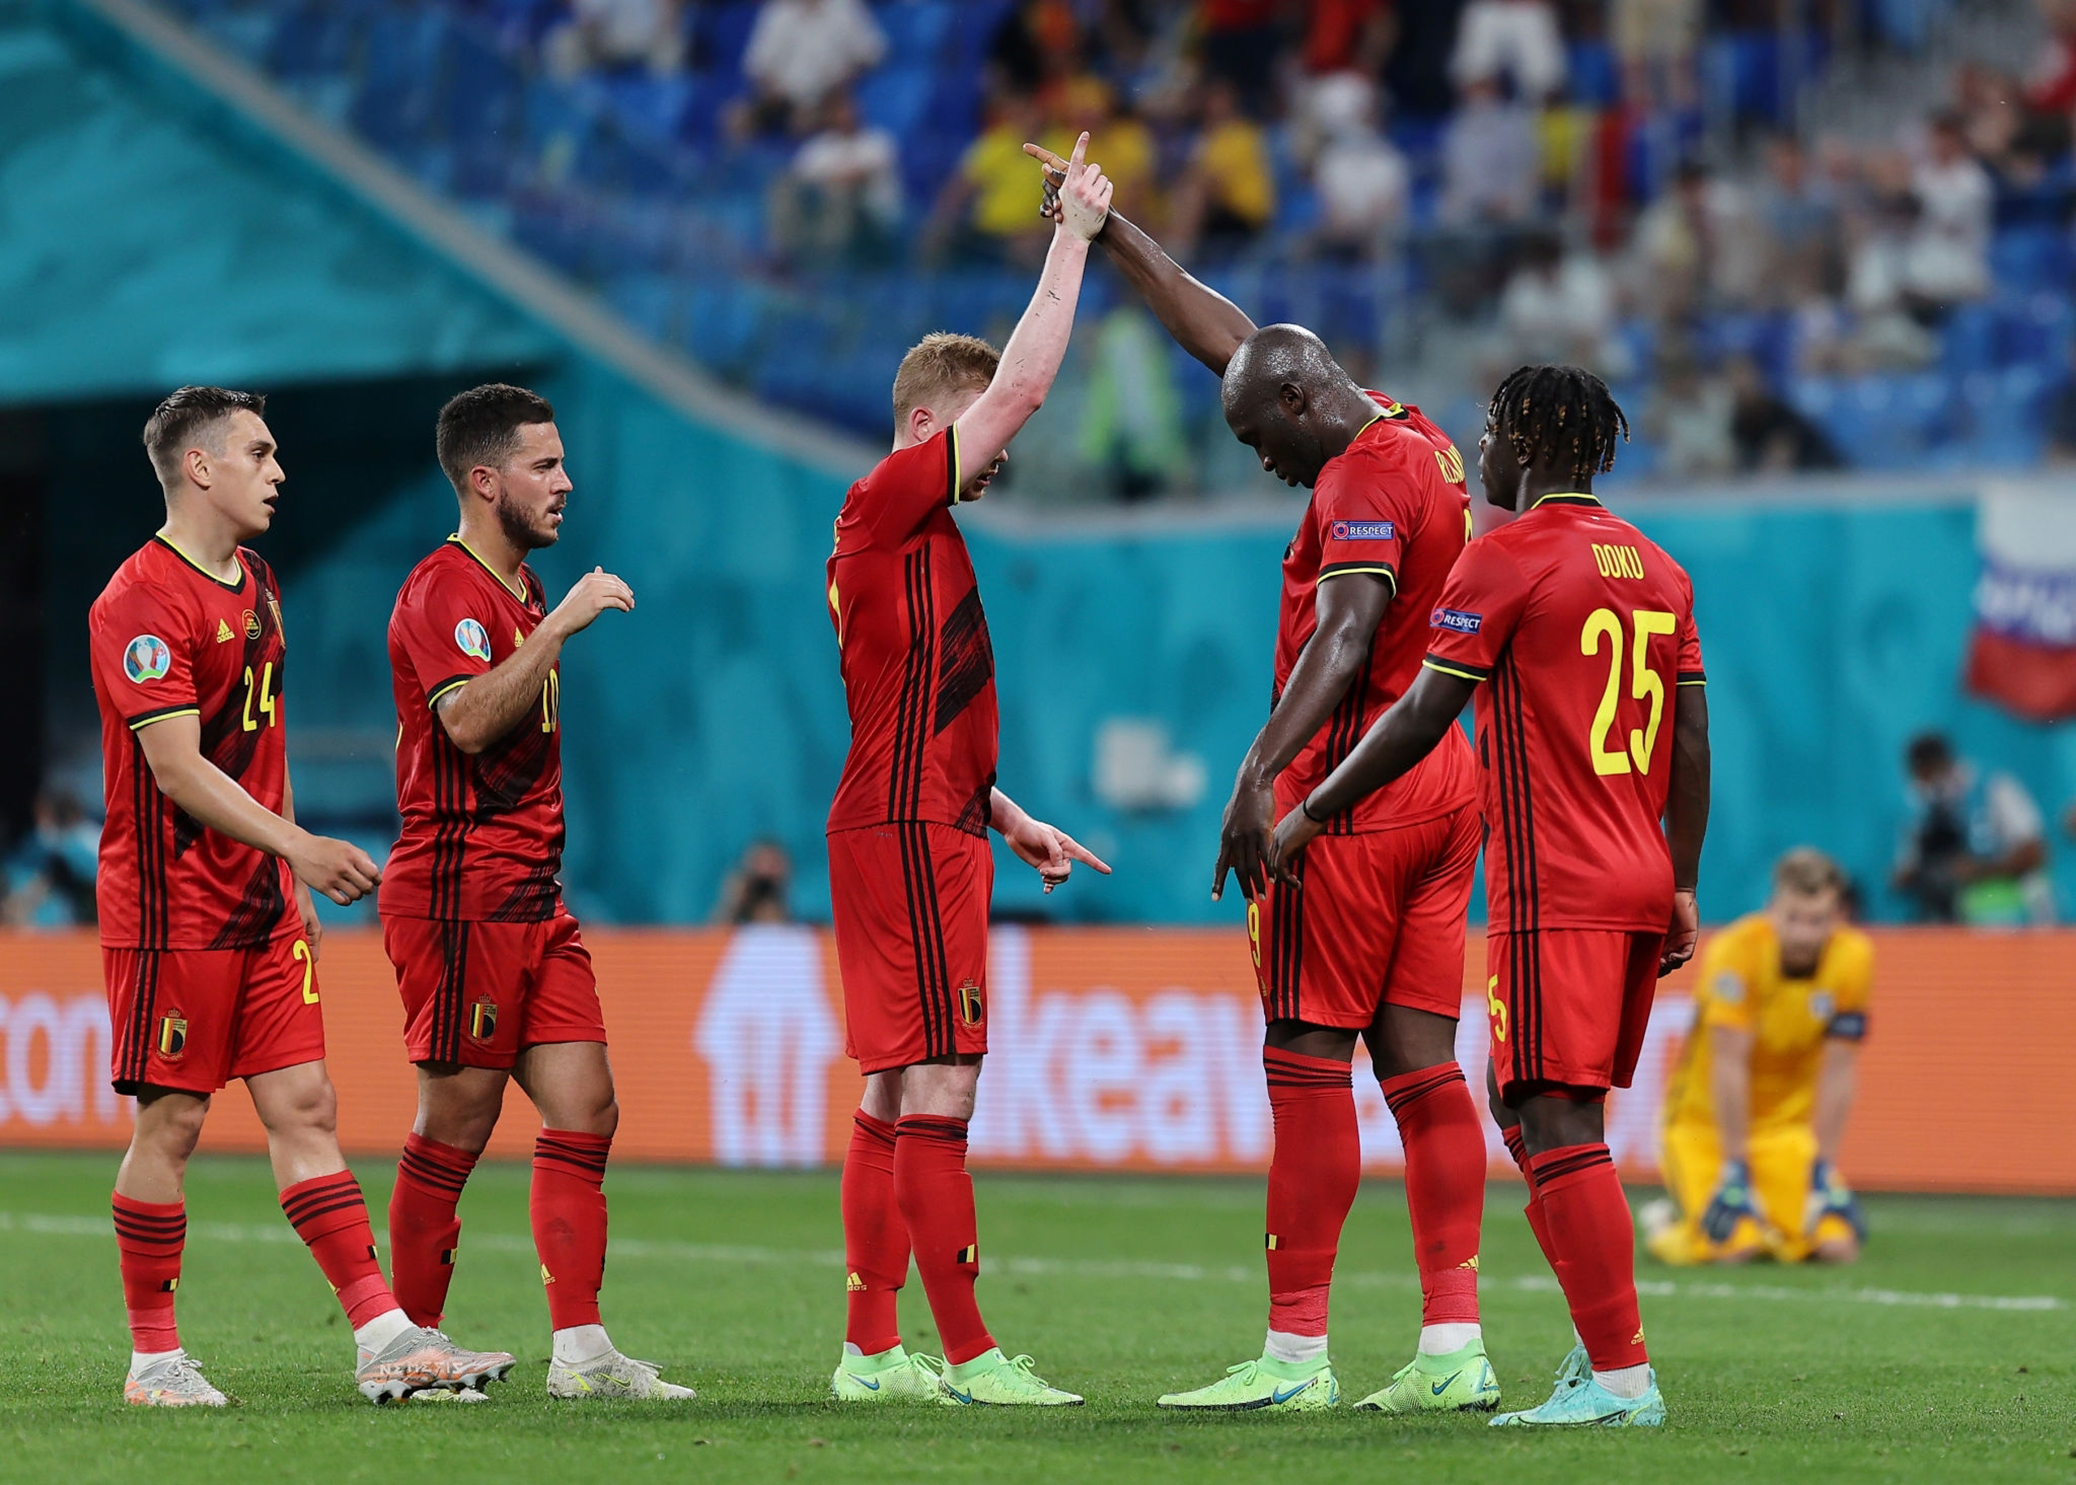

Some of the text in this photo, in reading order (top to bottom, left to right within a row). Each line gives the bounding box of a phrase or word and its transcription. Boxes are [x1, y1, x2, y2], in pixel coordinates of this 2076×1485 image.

[1350, 526, 1393, 536] RESPECT
[1591, 543, 1645, 580] DOKU
[1443, 614, 1480, 629] RESPECT
[243, 662, 275, 732] 24
[542, 668, 559, 732] 10
[1580, 608, 1676, 776] 25
[1247, 902, 1260, 968] 9
